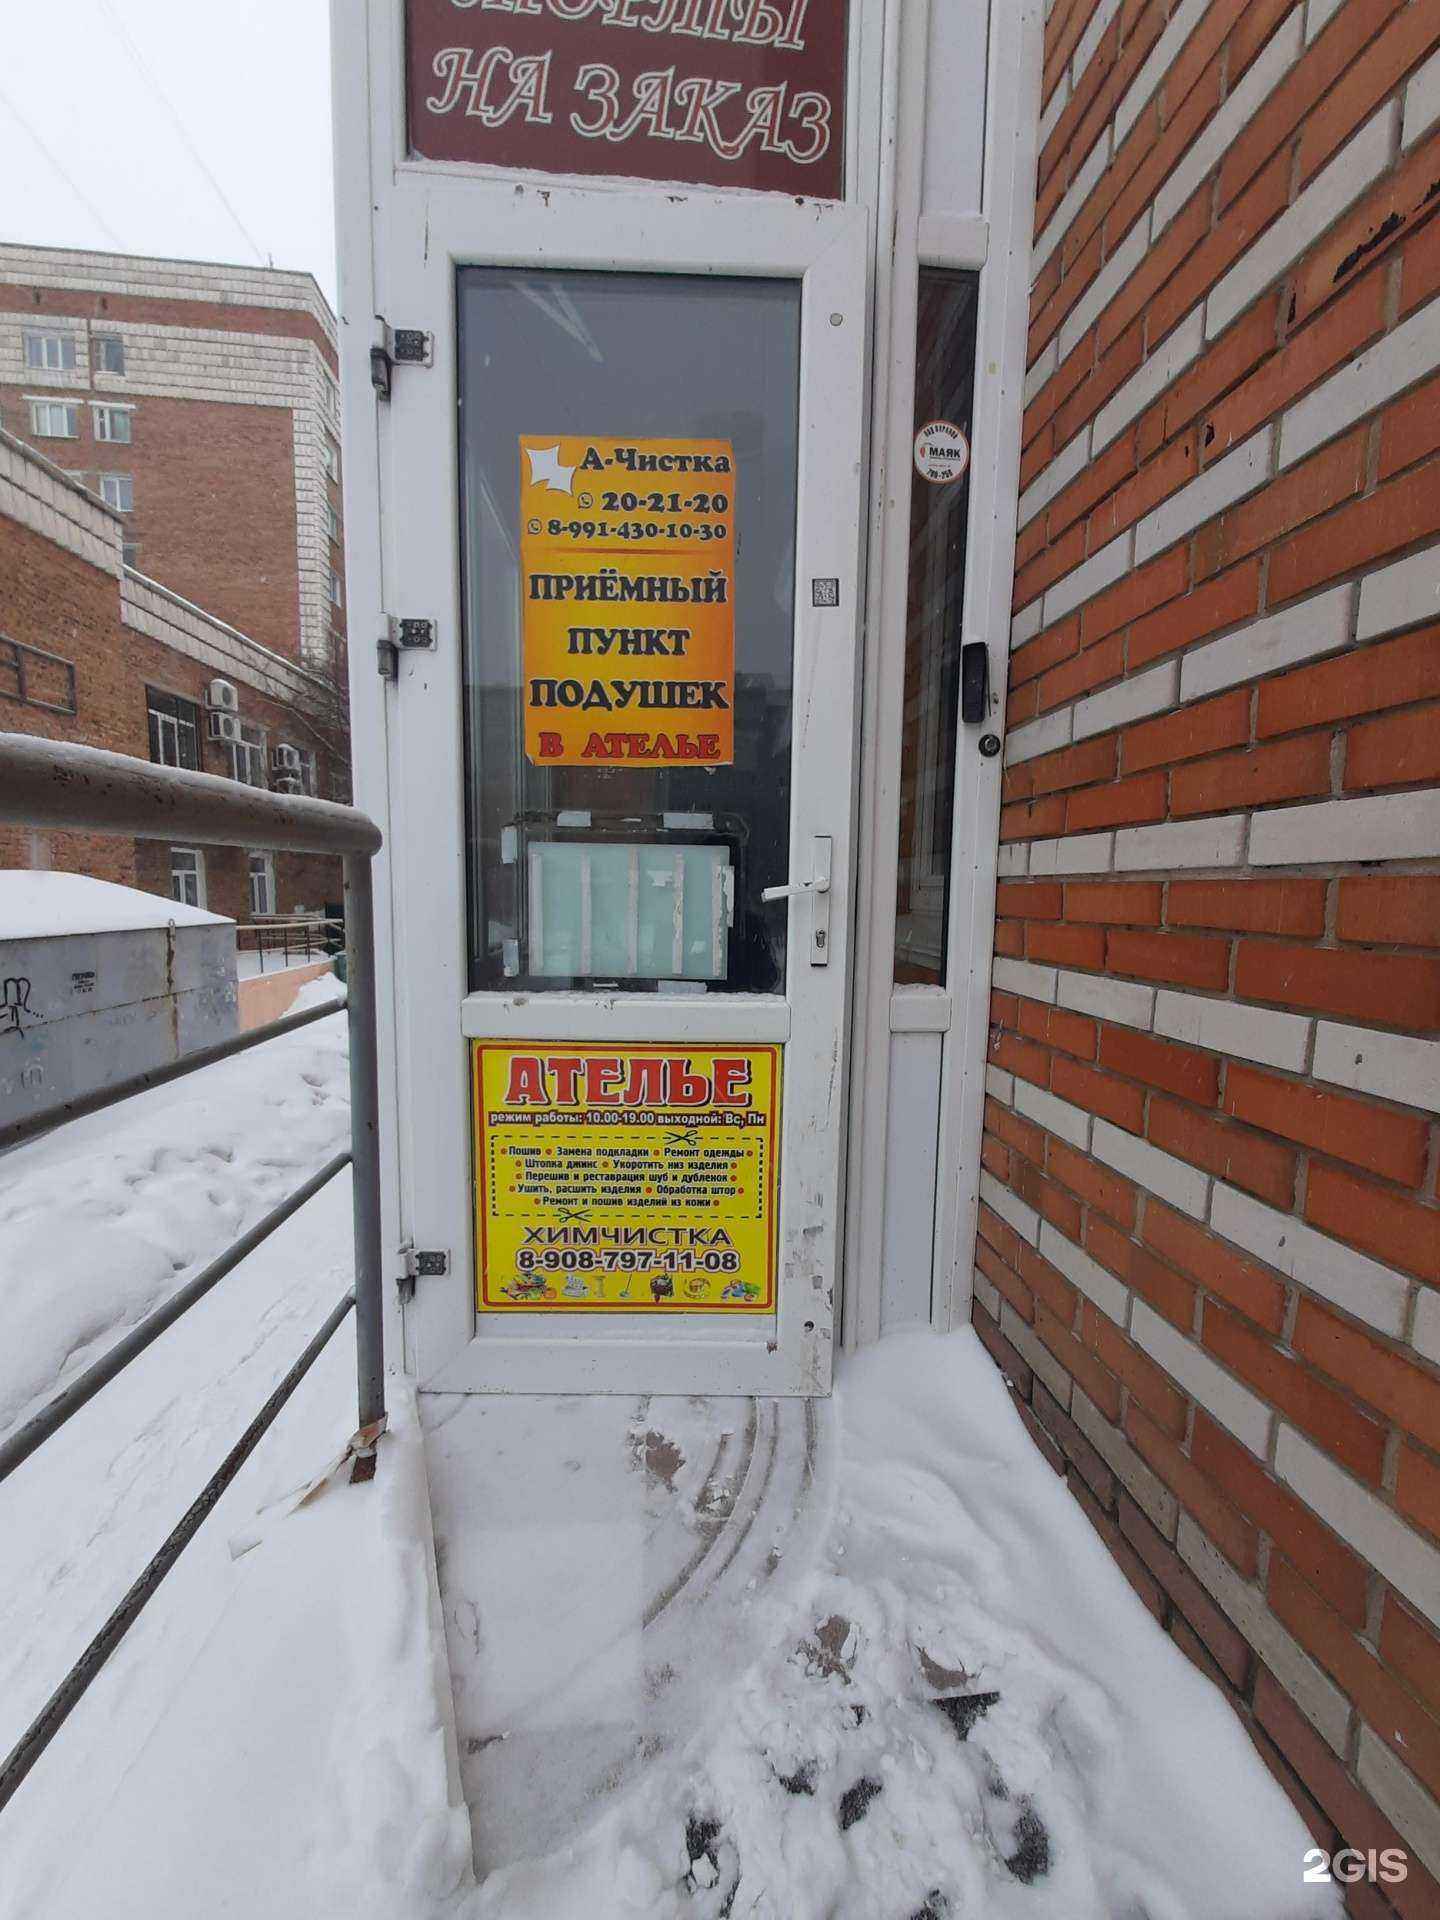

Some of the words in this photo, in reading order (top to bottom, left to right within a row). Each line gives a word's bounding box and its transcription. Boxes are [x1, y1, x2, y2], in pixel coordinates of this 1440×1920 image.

[426, 47, 553, 127] НА
[569, 63, 832, 164] ЗАКАЗ
[579, 446, 731, 473] А-Чистка
[929, 446, 961, 458] МАЯК
[601, 491, 729, 514] 20-21-20
[547, 518, 727, 541] 8-991-430-10-30
[529, 568, 727, 603] ПРИЁМНЫЙ
[567, 627, 690, 656] ПУНКТ
[529, 678, 730, 712] ПОДУШЕК
[538, 732, 564, 758] В
[581, 732, 721, 759] АТЕЛЬЕ
[504, 1056, 752, 1107] АТЕЛЬЕ
[490, 1112, 532, 1126] режим
[534, 1110, 583, 1126] работы:
[586, 1111, 655, 1124] 10.00-19.00
[657, 1111, 722, 1127] выходной:
[725, 1112, 745, 1128] Вс,
[747, 1112, 765, 1125] Пн
[508, 1146, 541, 1156] Пошив
[556, 1147, 592, 1157] Замена
[595, 1148, 649, 1158] подкладки
[664, 1147, 700, 1157] Ремонт
[703, 1149, 744, 1159] одежды
[525, 1159, 563, 1169] Штопка
[566, 1161, 598, 1170] джинс
[613, 1160, 664, 1171] Укоротить
[668, 1162, 684, 1170] низ
[688, 1161, 728, 1171] изделия
[525, 1171, 569, 1182] Перешив
[583, 1173, 645, 1183] реставрация
[648, 1172, 669, 1183] шуб
[681, 1173, 728, 1183] дубленок
[542, 1196, 578, 1206] Ремонт
[591, 1198, 623, 1206] пошив
[627, 1197, 667, 1207] изделий
[671, 1198, 682, 1206] из
[685, 1199, 711, 1207] кожи
[556, 1185, 597, 1195] расшить
[601, 1186, 641, 1195] изделия
[656, 1184, 707, 1196] Обработка
[711, 1186, 736, 1196] штор
[523, 1226, 732, 1246] ХИМЧИСТКА
[516, 1249, 740, 1272] 8-908-797-11-08
